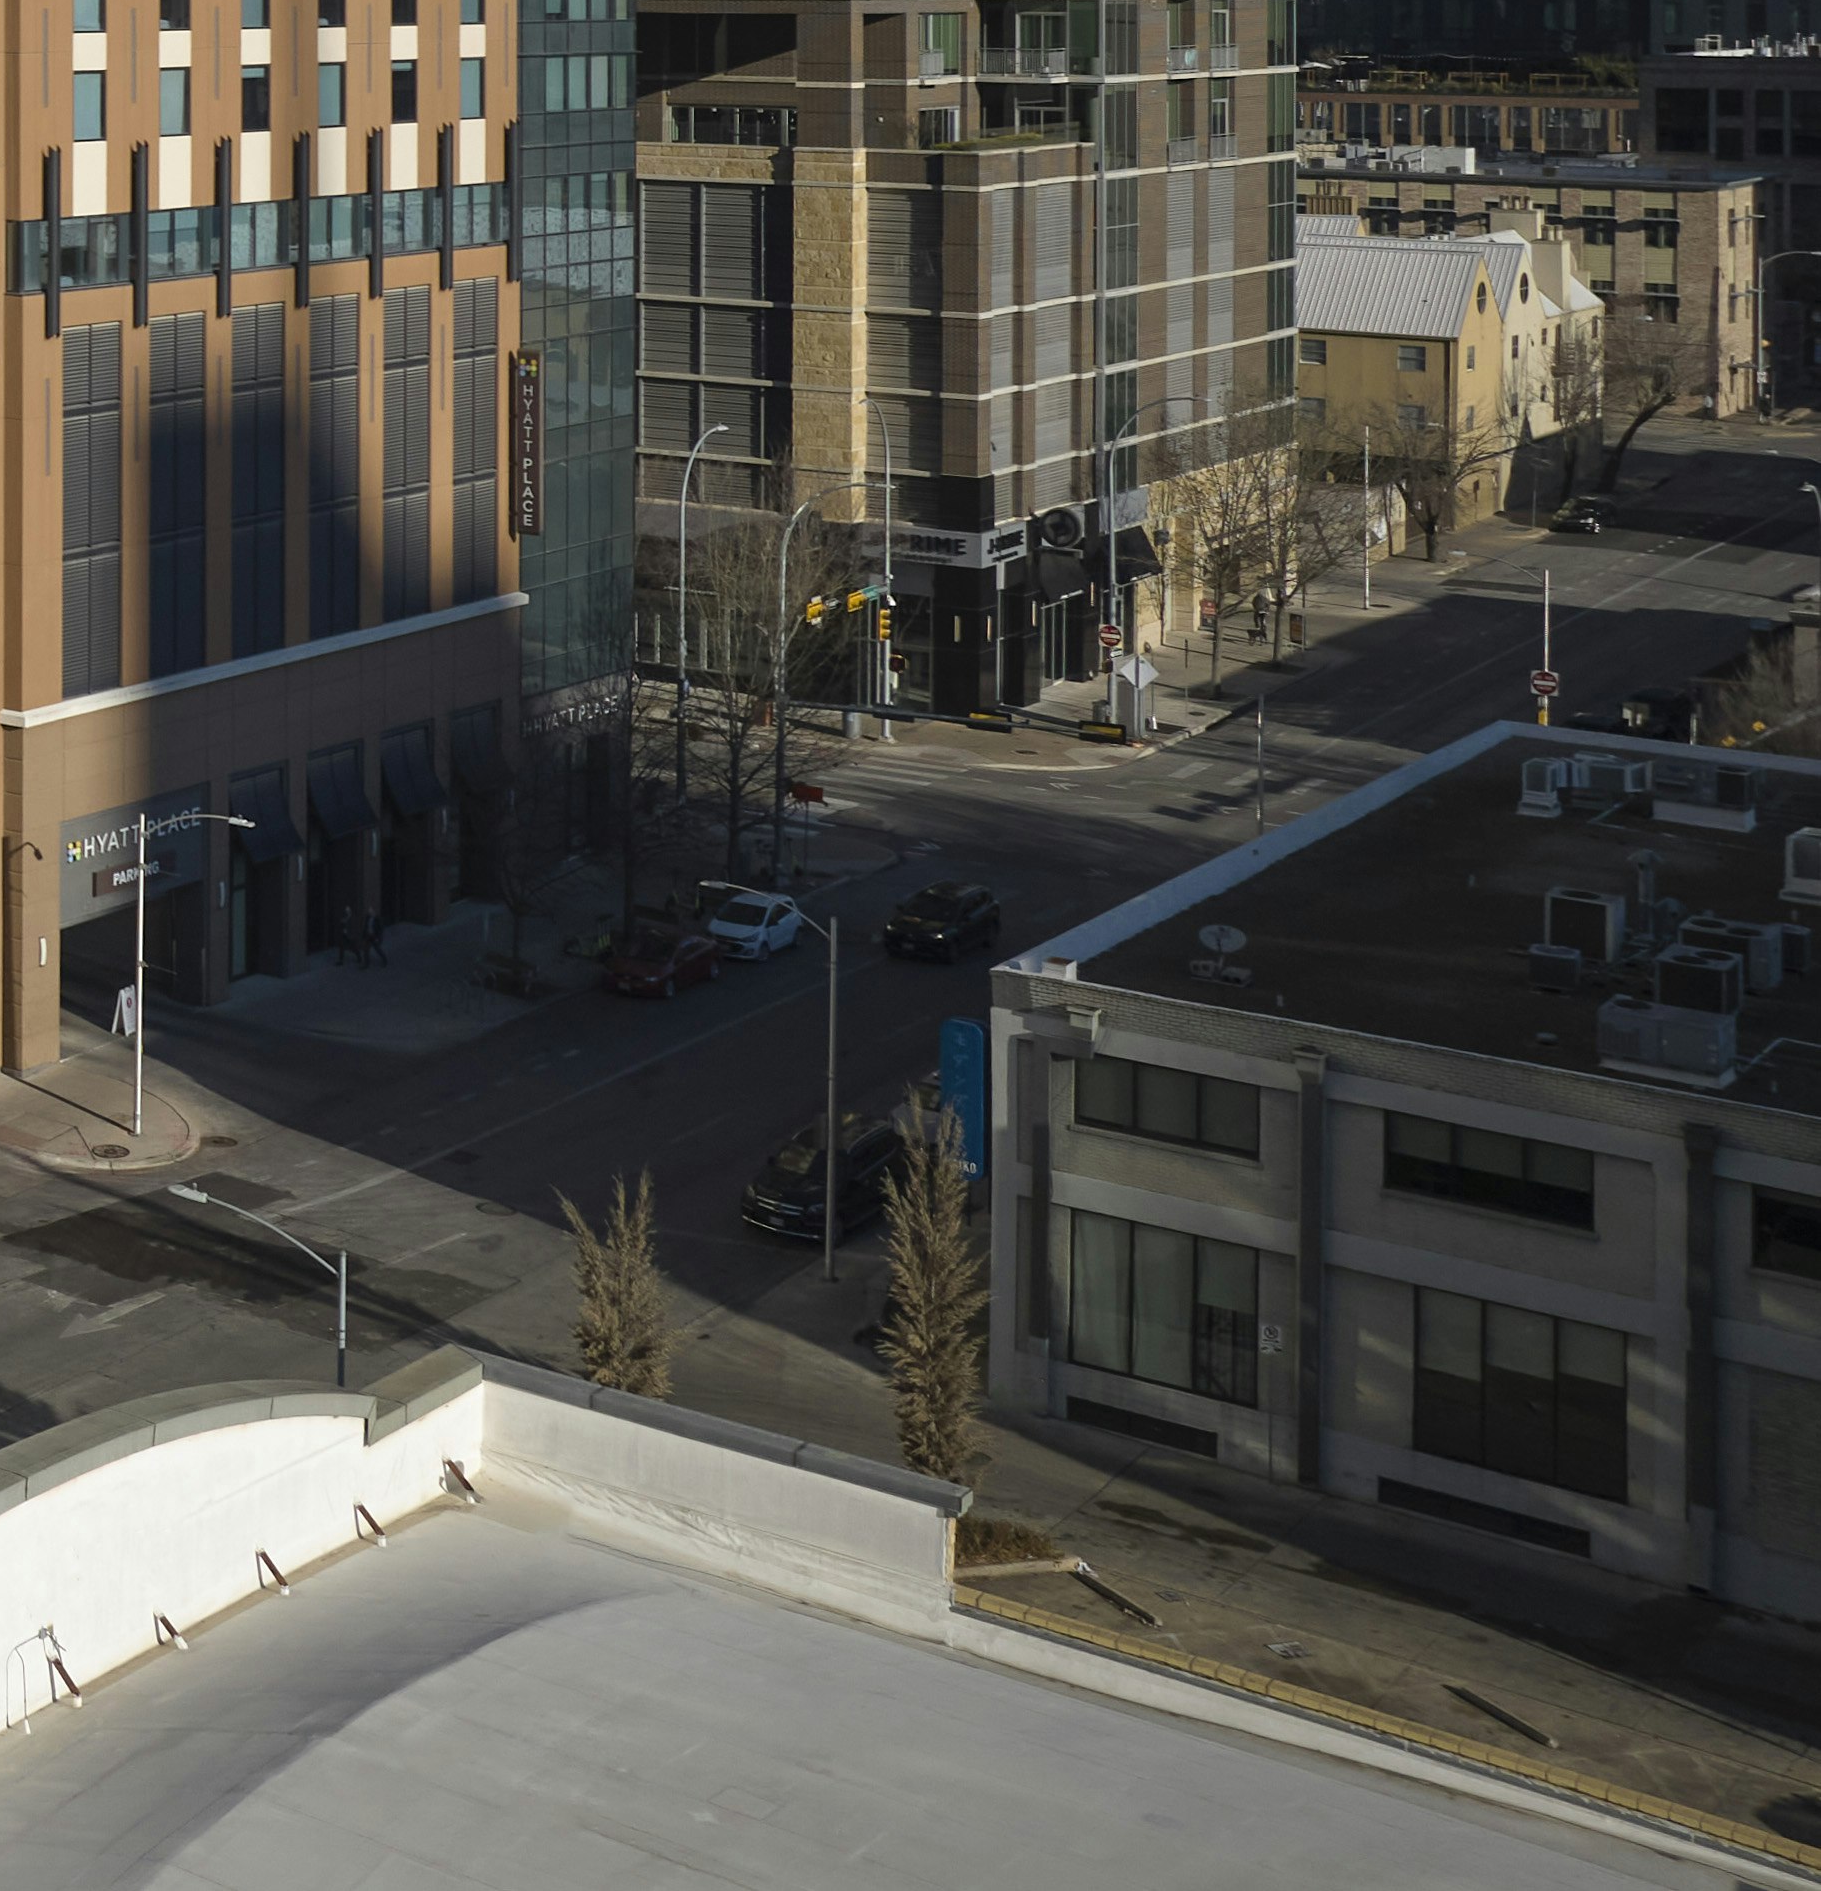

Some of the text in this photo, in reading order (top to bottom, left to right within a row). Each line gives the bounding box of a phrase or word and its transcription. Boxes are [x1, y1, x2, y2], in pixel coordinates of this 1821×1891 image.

[522, 385, 534, 526] HYATT PLACE
[84, 807, 201, 858] HYATT PLACE
[113, 861, 160, 886] PARKNG
